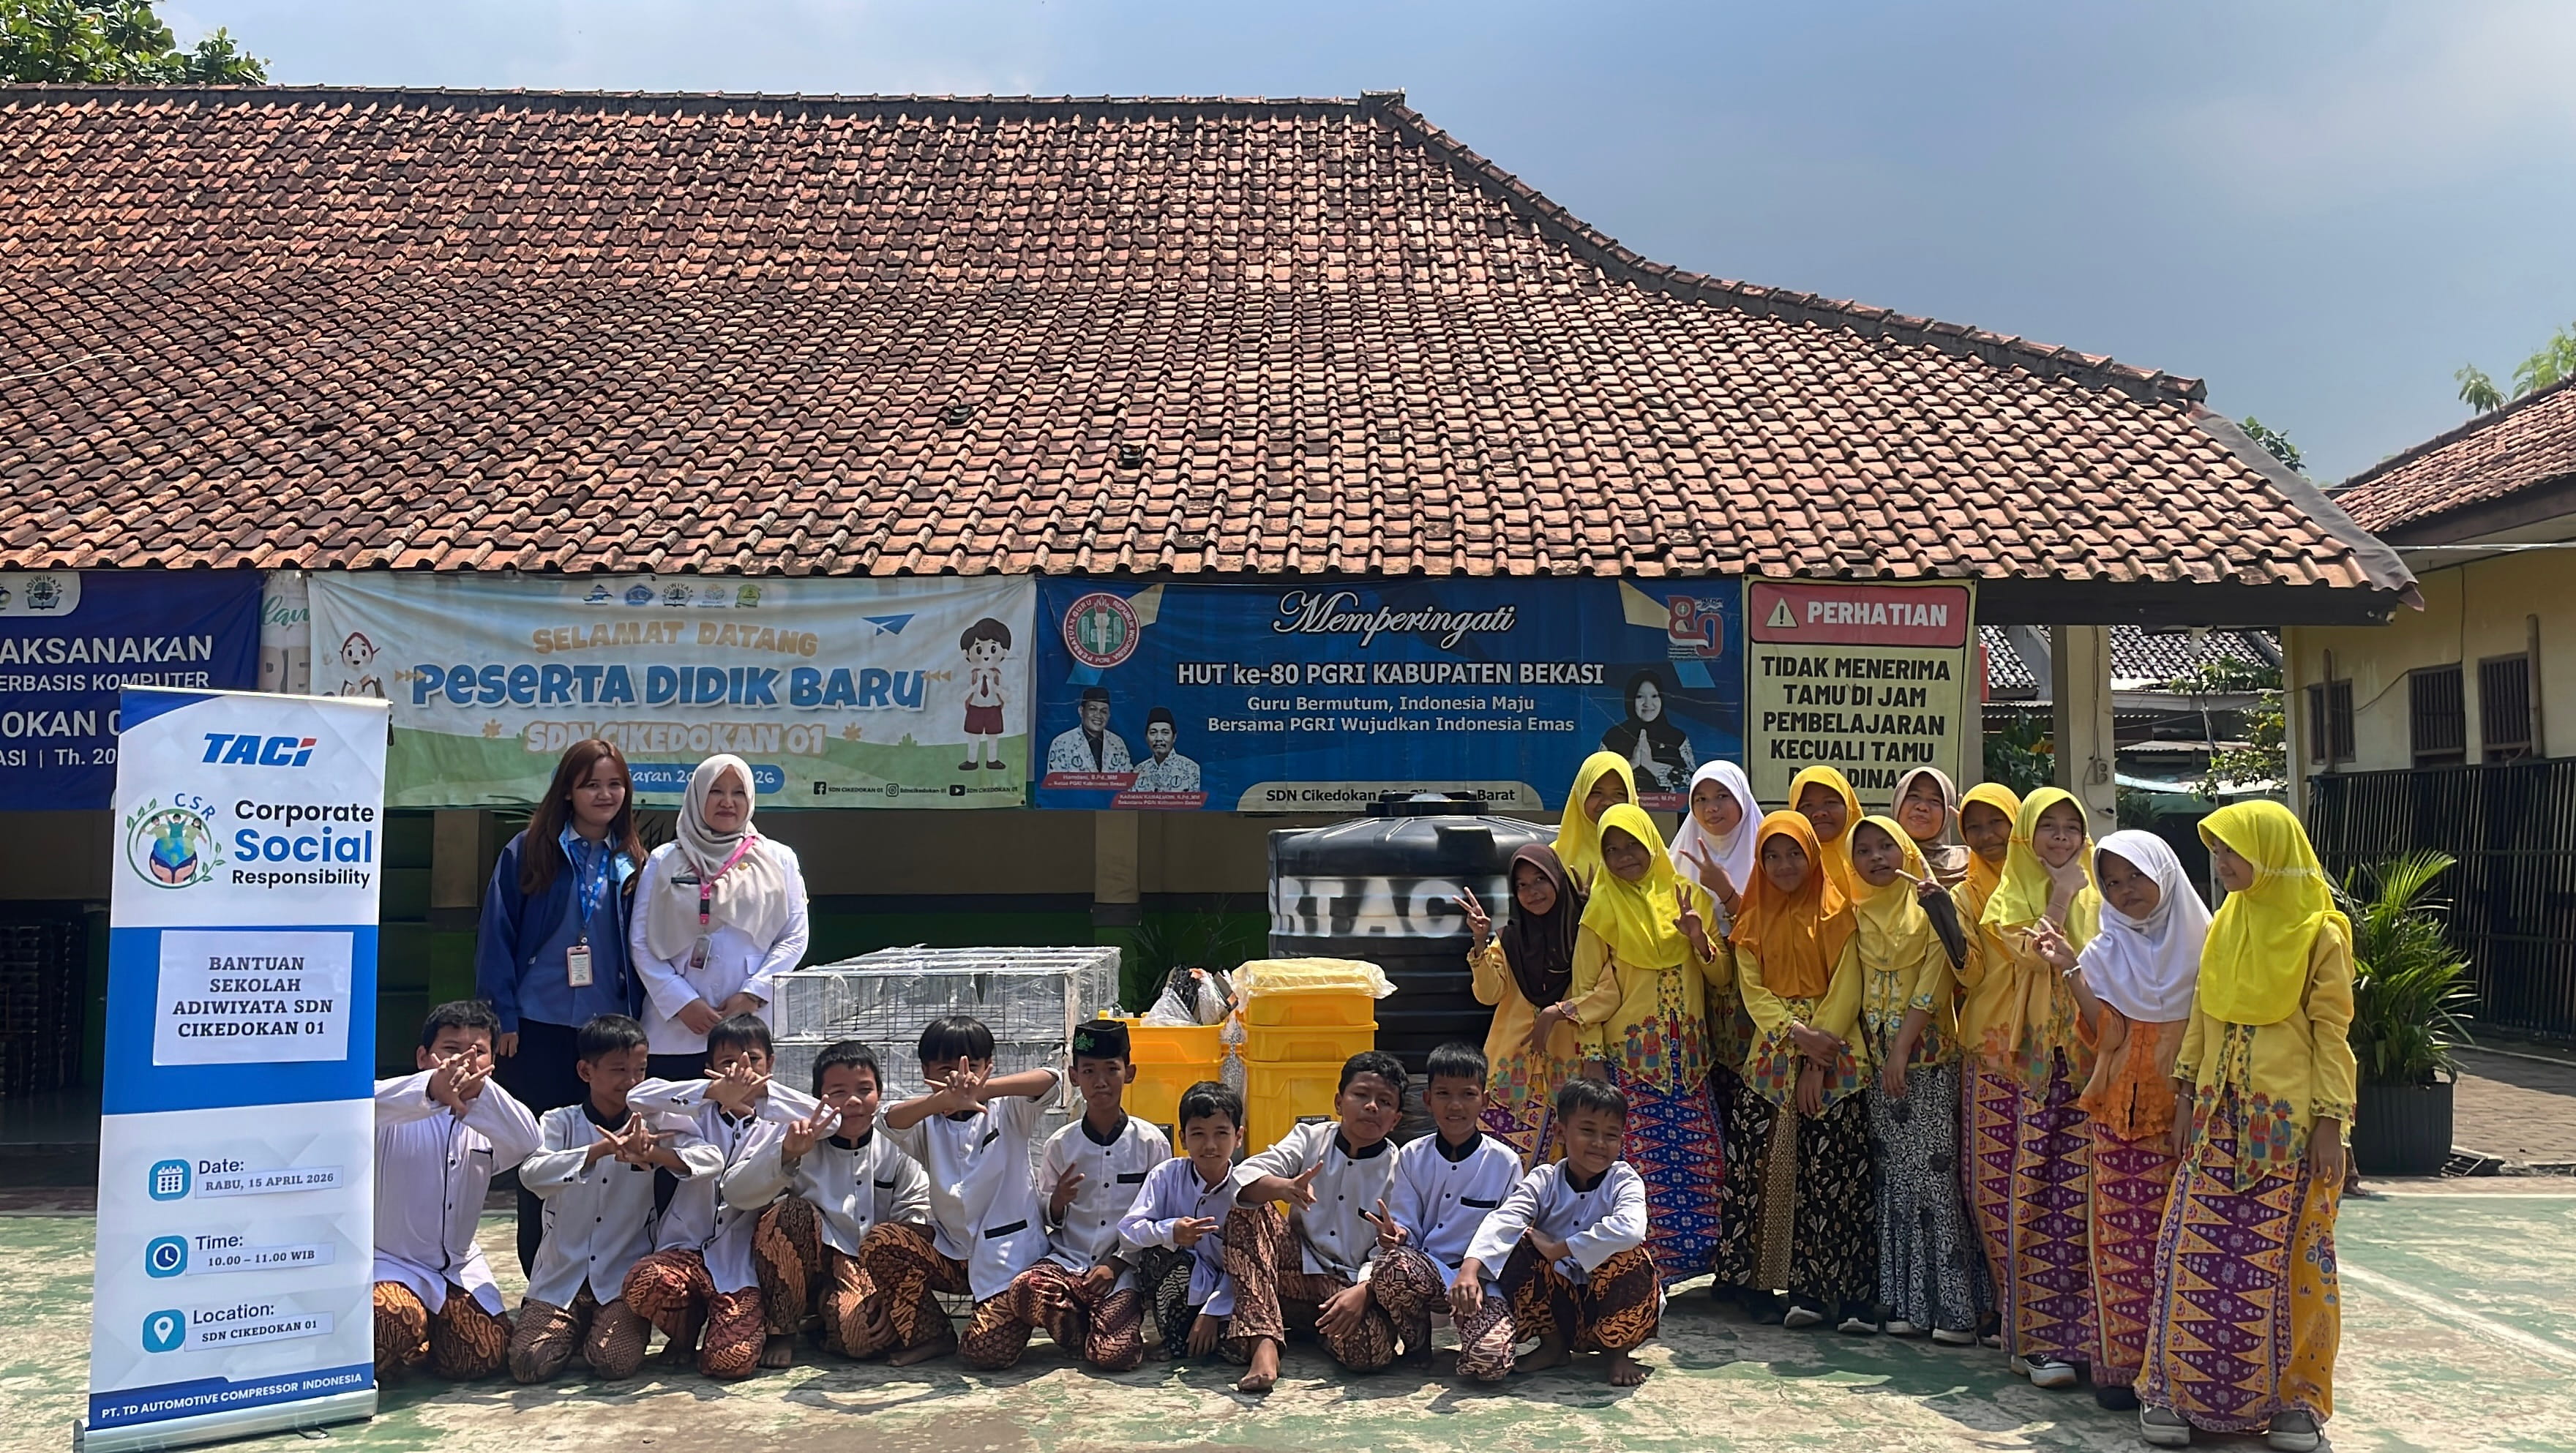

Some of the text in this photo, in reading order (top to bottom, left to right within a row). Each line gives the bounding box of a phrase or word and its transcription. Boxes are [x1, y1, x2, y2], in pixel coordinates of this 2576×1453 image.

[25, 574, 64, 595] ADIWIYATA
[1072, 599, 1092, 617] GURU
[1808, 601, 1947, 627] PERHATIAN
[1273, 590, 1515, 649] Memperingati
[533, 621, 819, 657] SELAMAT DATANG
[1177, 663, 1604, 684] HUT ke-80 PGRI KABUPATEN BEKASI
[1761, 656, 1950, 680] TIDAK MENERIMA
[92, 671, 209, 691] KOMPUTER
[647, 665, 780, 706] DIDIK
[790, 667, 925, 708] BARU
[1248, 696, 1535, 713] Guru Bermutum, Indonesia Maju
[1783, 684, 1926, 707] TAMU DI JAM
[1208, 717, 1575, 734] Bersama PGRI Wujudkan Indonesia Emas
[1763, 712, 1944, 736] PEMBELAJARAN
[526, 721, 592, 752] SDN
[787, 723, 825, 754] 01
[54, 748, 85, 765] Th.
[1770, 739, 1934, 763] KECUALI TAMU
[1266, 790, 1297, 801] SDN
[1301, 789, 1377, 802] Cikedokan
[1478, 789, 1515, 801] Barat
[174, 792, 217, 821] CSR
[235, 800, 374, 827] Corporate
[234, 826, 372, 863] Social
[232, 869, 370, 889] Responsibility
[209, 957, 304, 971] BANTUAN
[209, 978, 302, 993] SEKOLAH
[172, 999, 333, 1015] ADIWIYATA SDN
[178, 1021, 325, 1037] CIKEDOKAN 01
[198, 1158, 245, 1176] Date:
[205, 1172, 334, 1192] RABU, 15 APRIL 2026
[195, 1234, 244, 1250] Time:
[209, 1255, 241, 1267] 10.00
[255, 1252, 287, 1264] 11.00
[291, 1250, 315, 1261] WIB
[193, 1303, 275, 1325] Location:
[202, 1320, 318, 1343] SDN CIKEDOKAN 01
[101, 1372, 362, 1419] PT. TD AUTOMOTIVE COMPRESSOR INDONESIA
